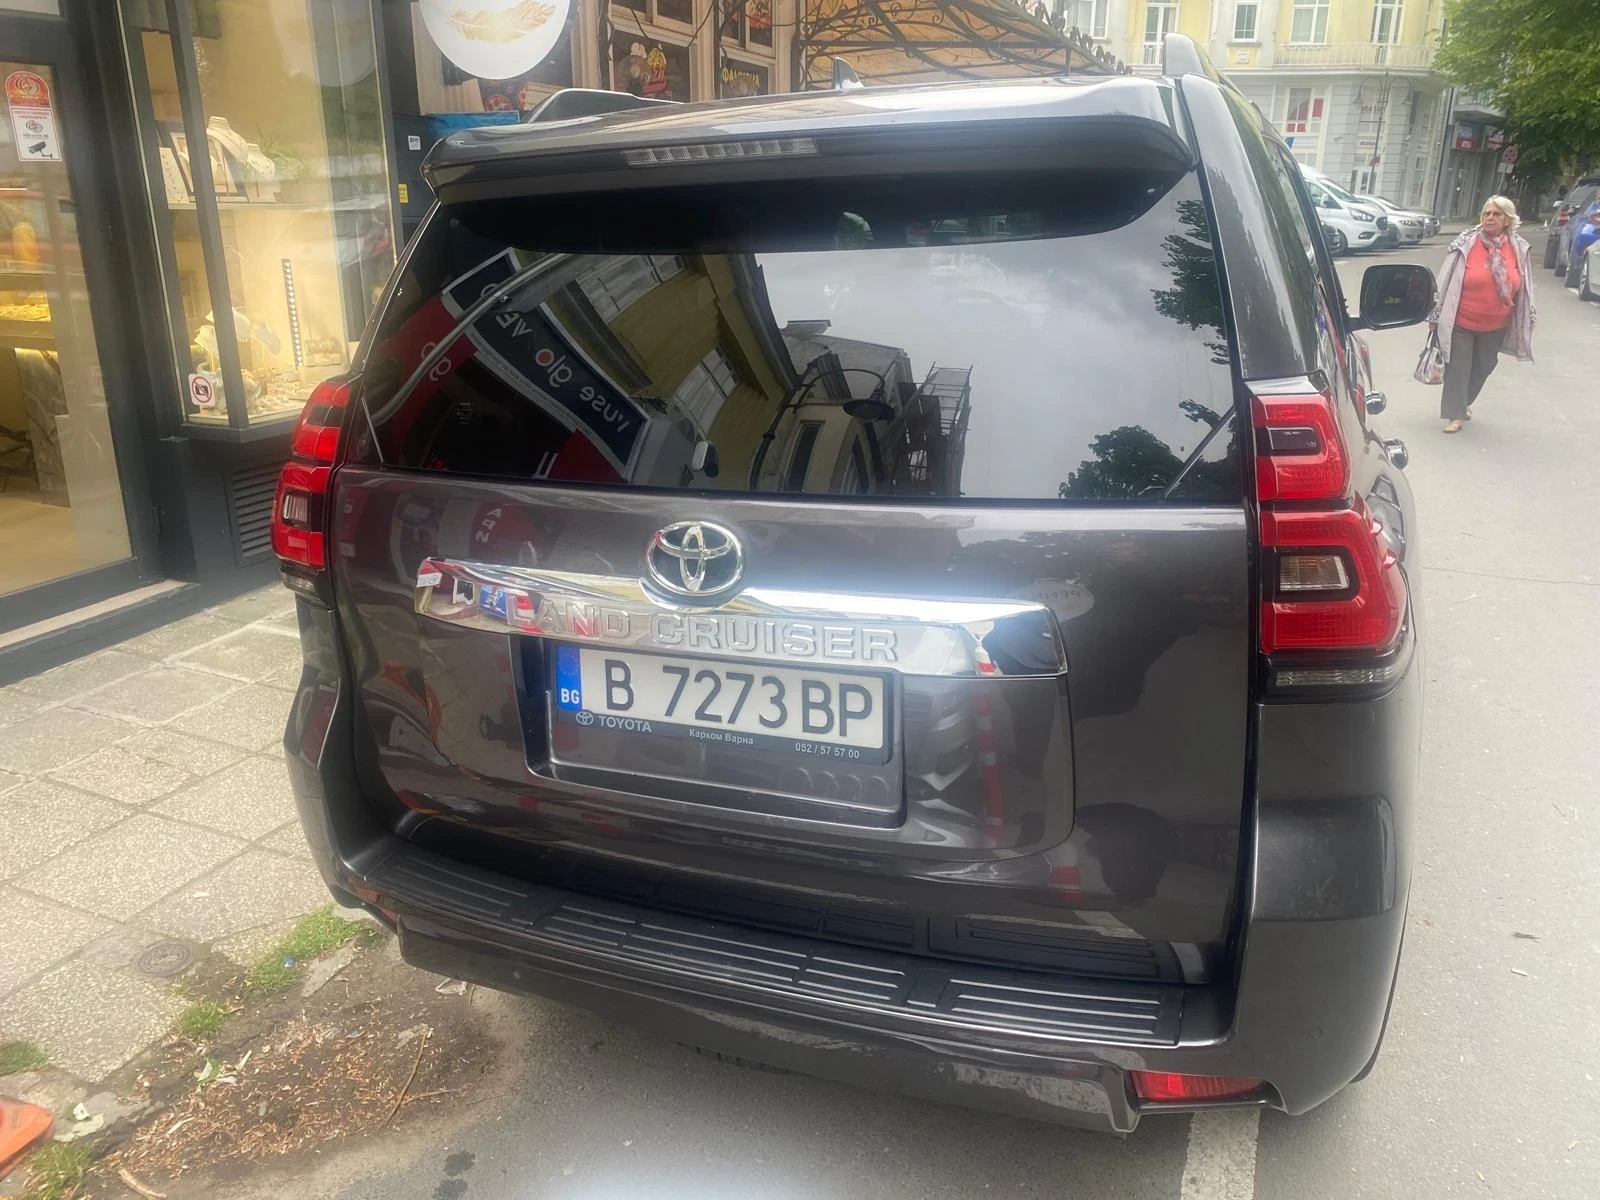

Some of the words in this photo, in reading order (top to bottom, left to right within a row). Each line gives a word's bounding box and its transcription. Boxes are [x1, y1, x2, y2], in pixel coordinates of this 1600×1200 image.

[506, 594, 631, 638] LAND
[649, 612, 899, 662] CRUISER
[560, 687, 580, 704] BG
[604, 659, 635, 711] B
[662, 665, 788, 729] 7273
[801, 679, 873, 737] BP
[598, 715, 652, 733] TOYOTA
[689, 729, 723, 741] Карком
[724, 733, 754, 745] Варна
[795, 742, 812, 754] 052
[820, 746, 831, 756] 57
[834, 748, 845, 757] 57
[847, 749, 860, 759] 00
